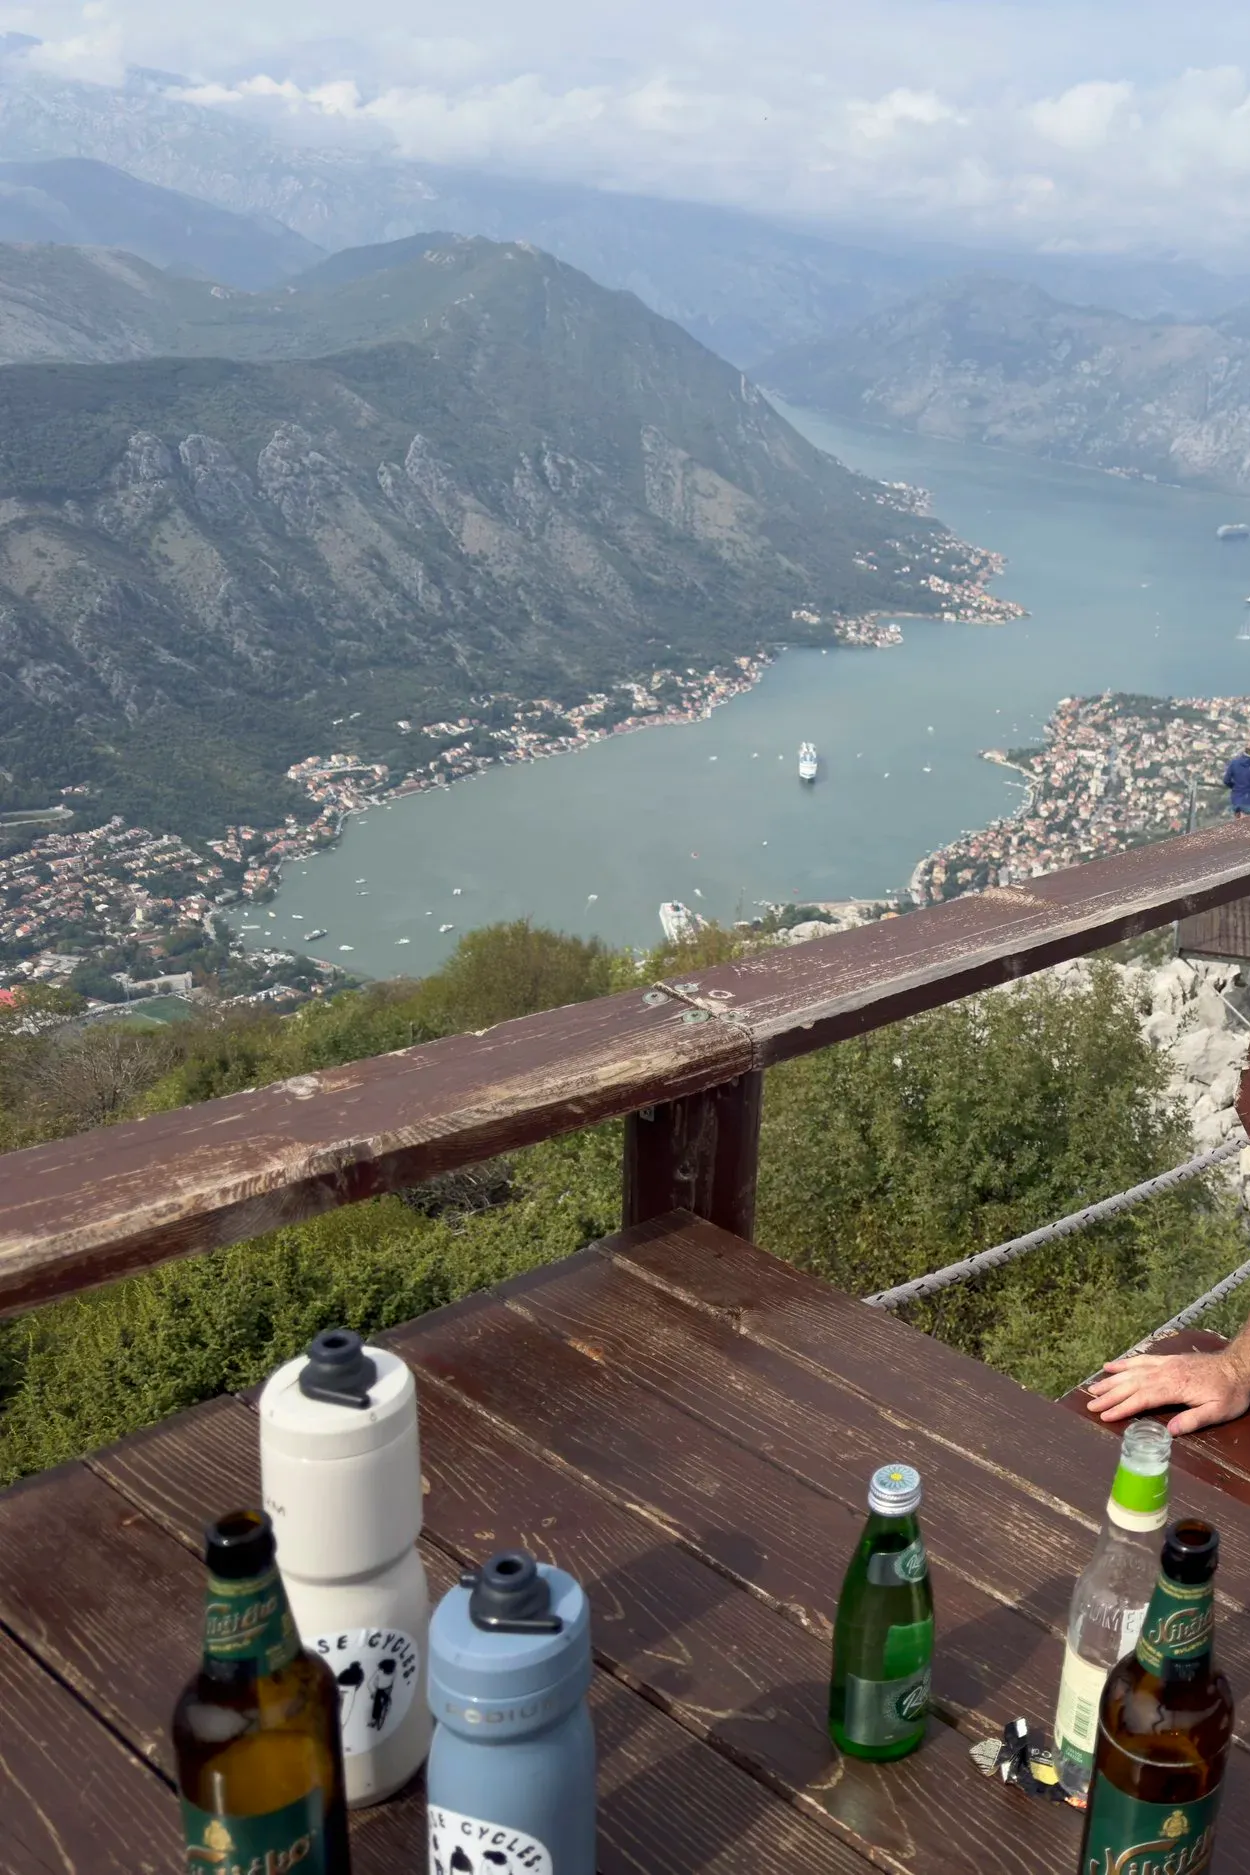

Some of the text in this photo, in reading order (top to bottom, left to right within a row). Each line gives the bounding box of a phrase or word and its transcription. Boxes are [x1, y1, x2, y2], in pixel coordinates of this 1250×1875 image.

[316, 1634, 349, 1654] SE
[445, 1702, 554, 1725] PODIU
[460, 1820, 543, 1873] CYCLES.
